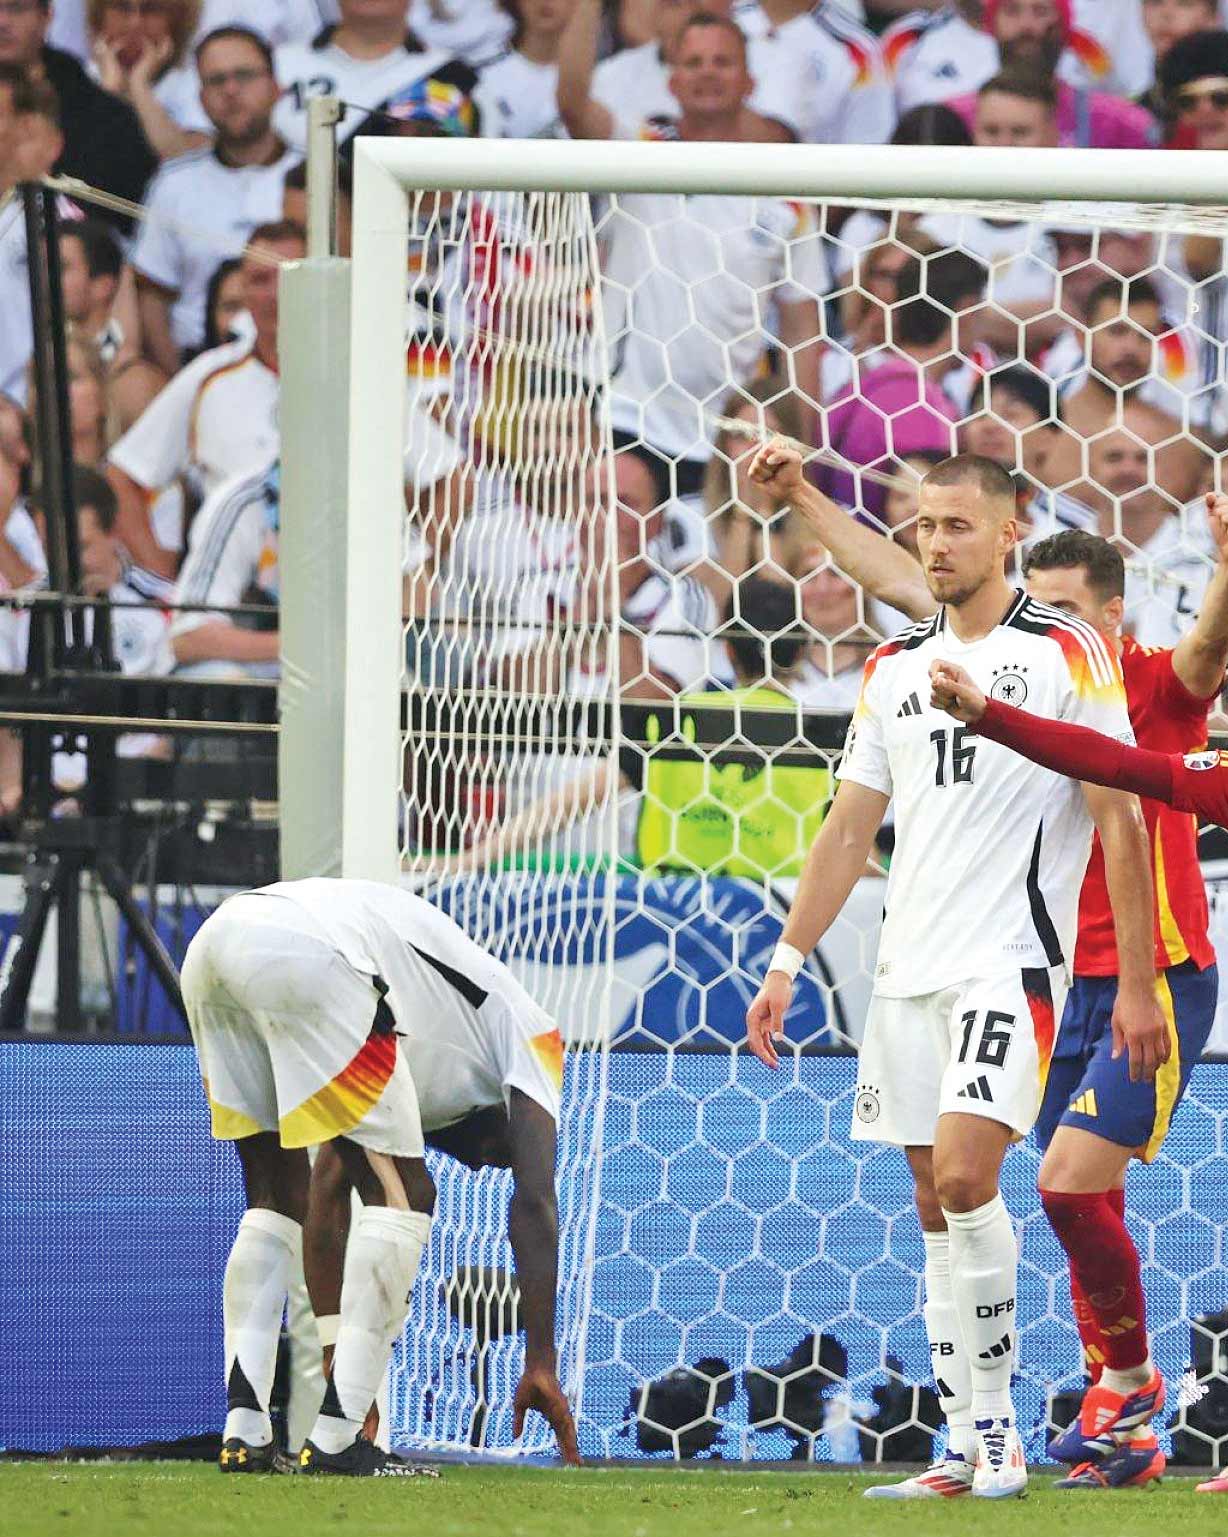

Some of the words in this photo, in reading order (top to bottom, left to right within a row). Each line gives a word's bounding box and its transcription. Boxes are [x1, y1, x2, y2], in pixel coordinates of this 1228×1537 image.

[930, 726, 979, 788] 16
[958, 1009, 1017, 1071] 16
[975, 1297, 1015, 1319] DFB
